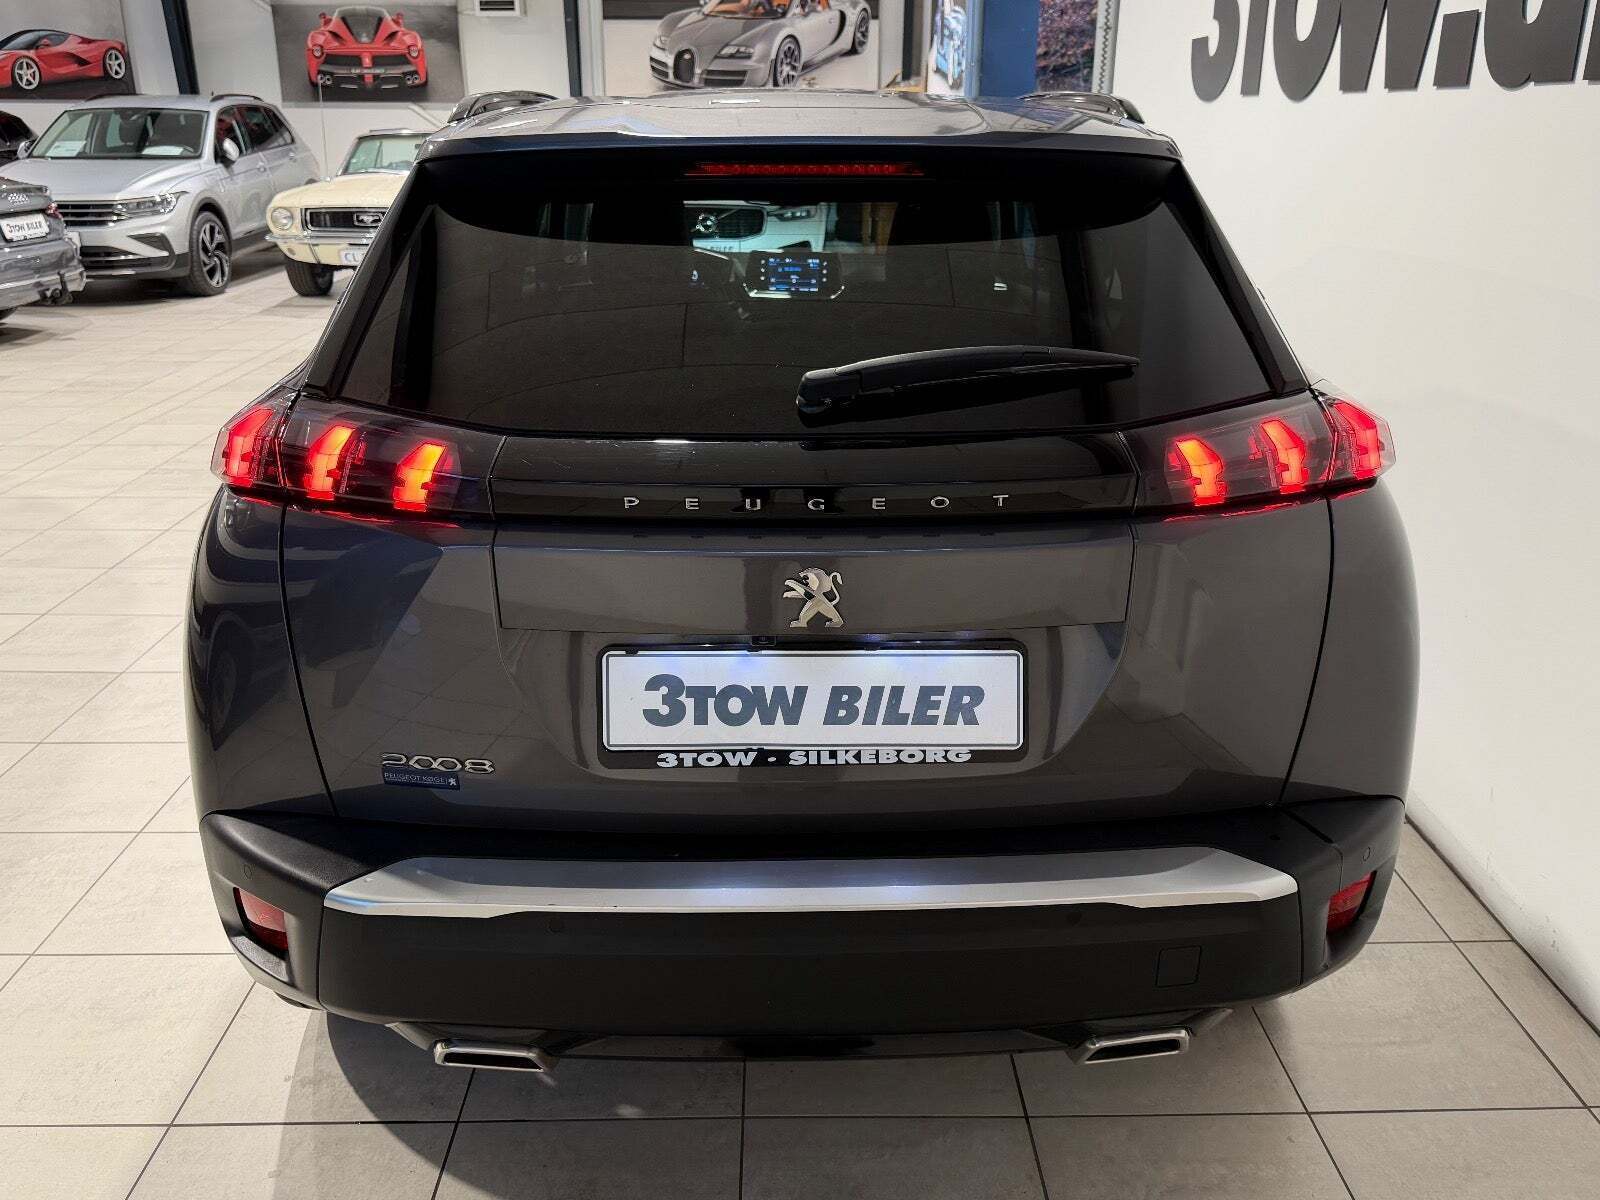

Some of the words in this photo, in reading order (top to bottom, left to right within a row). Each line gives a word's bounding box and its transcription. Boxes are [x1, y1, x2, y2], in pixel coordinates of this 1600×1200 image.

[623, 494, 1009, 511] PEUGEOT
[642, 673, 809, 727] 3TOW
[823, 685, 985, 726] BILER
[382, 753, 495, 774] 2008
[656, 751, 758, 768] 3TOW
[788, 749, 972, 766] SILKEBORG
[384, 772, 421, 781] PEUGEOT
